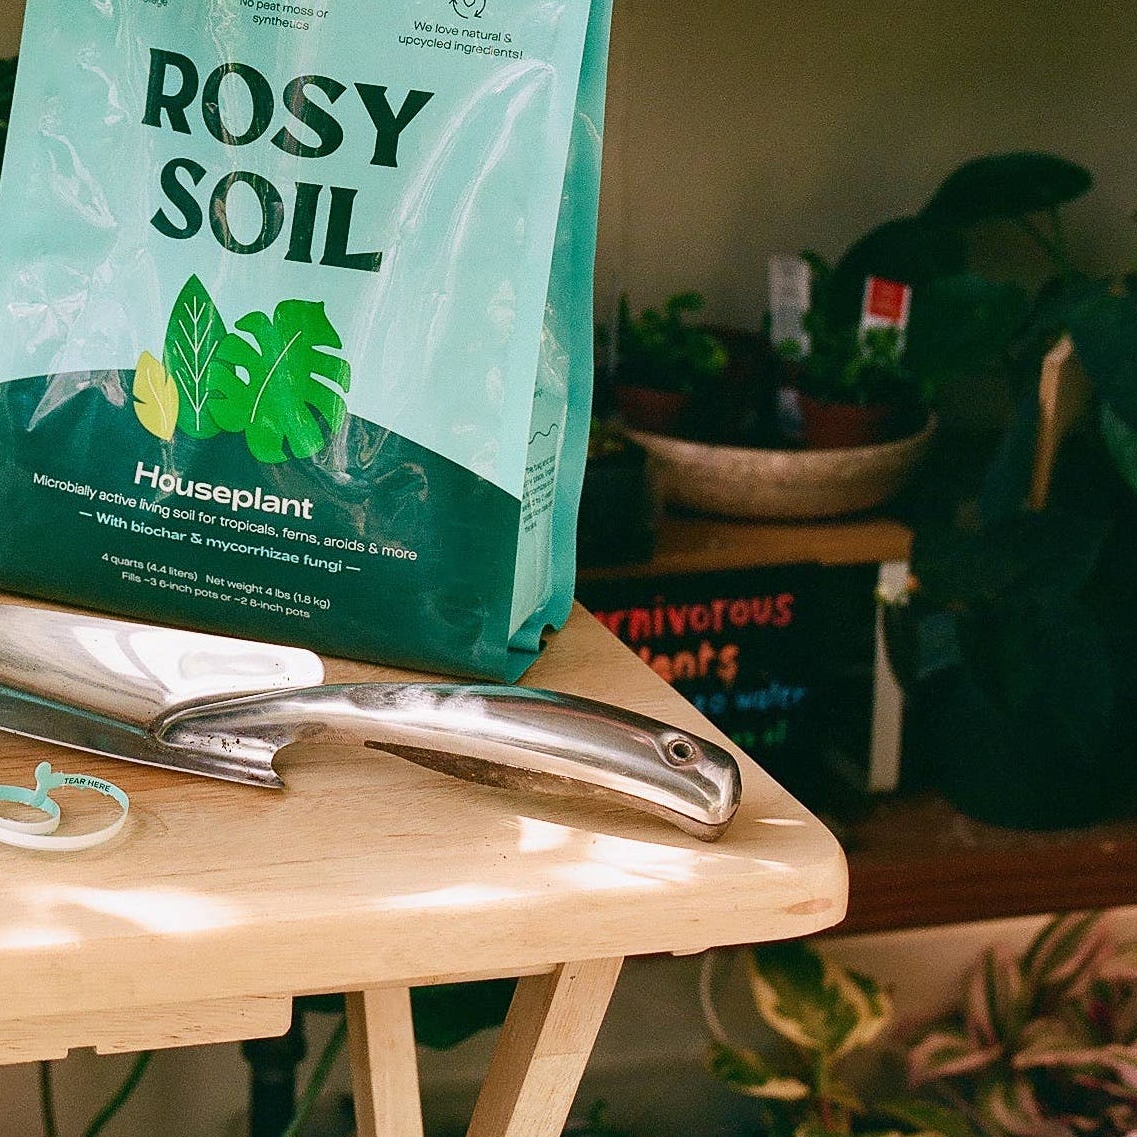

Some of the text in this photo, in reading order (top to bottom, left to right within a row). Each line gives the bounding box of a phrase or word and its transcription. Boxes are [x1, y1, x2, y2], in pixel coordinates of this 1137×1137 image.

[252, 14, 310, 31] synthetics
[256, 0, 281, 11] peat
[283, 5, 314, 16] moss
[316, 10, 328, 18] or
[413, 20, 512, 43] We love natural &
[398, 35, 523, 60] upcycled ingredients!
[141, 47, 435, 168] ROSY
[150, 157, 383, 273] SOIL
[33, 472, 418, 561] Microbially active living soil for tropicals, ferns, aroids & more
[133, 461, 314, 520] Houseplant
[96, 511, 128, 530] With
[130, 520, 187, 541] biochar
[190, 532, 203, 545] &
[206, 538, 300, 564] mycorrhizae
[303, 554, 342, 573] fungi
[101, 552, 331, 610] 4 quarts (4.4 liters) Net weight 4 lbs (1.8 kg)
[121, 571, 142, 583] Fills
[158, 579, 192, 594] 6-inch
[194, 587, 219, 599] pots
[220, 594, 232, 602] or
[249, 598, 284, 613] 8-inch
[285, 607, 311, 618] pots
[594, 591, 796, 643] rnivorous
[64, 777, 112, 793] TEAR HERE
